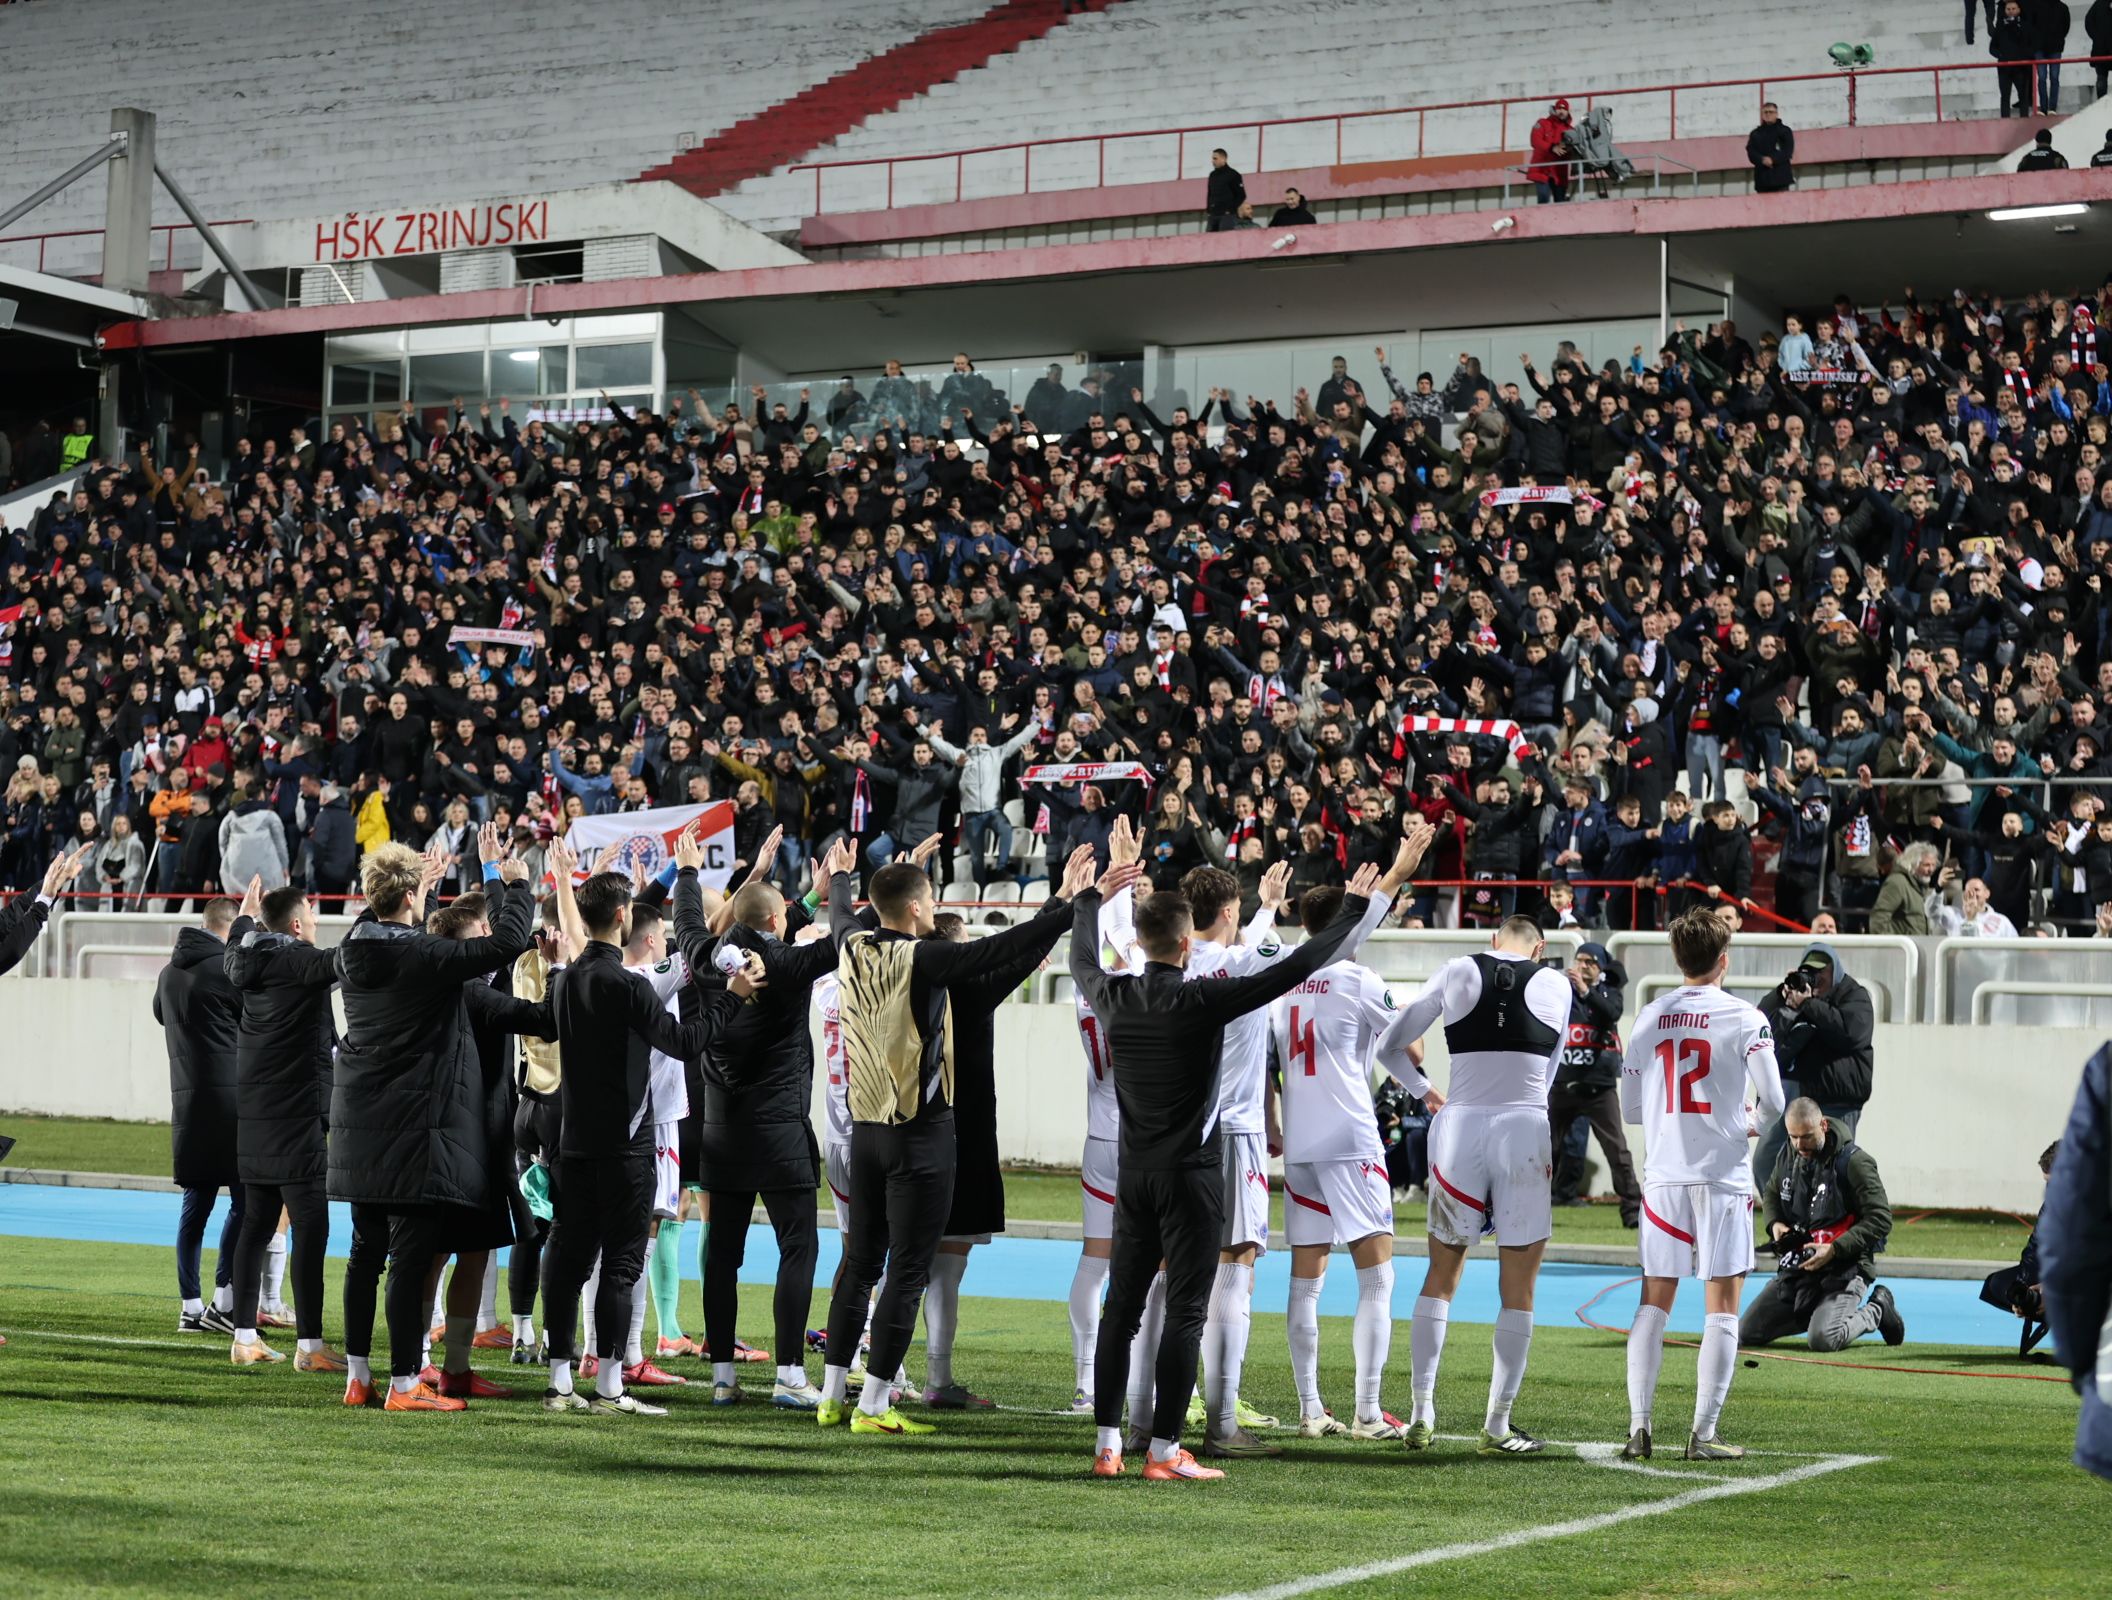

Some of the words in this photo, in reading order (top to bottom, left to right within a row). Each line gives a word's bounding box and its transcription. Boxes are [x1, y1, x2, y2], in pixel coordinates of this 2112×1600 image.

[315, 211, 384, 261] HŠK
[394, 201, 548, 254] ZRINJSKI
[1289, 1005, 1316, 1076] 4
[1658, 1013, 1710, 1030] MAMIĆ
[1655, 1037, 1712, 1114] 12
